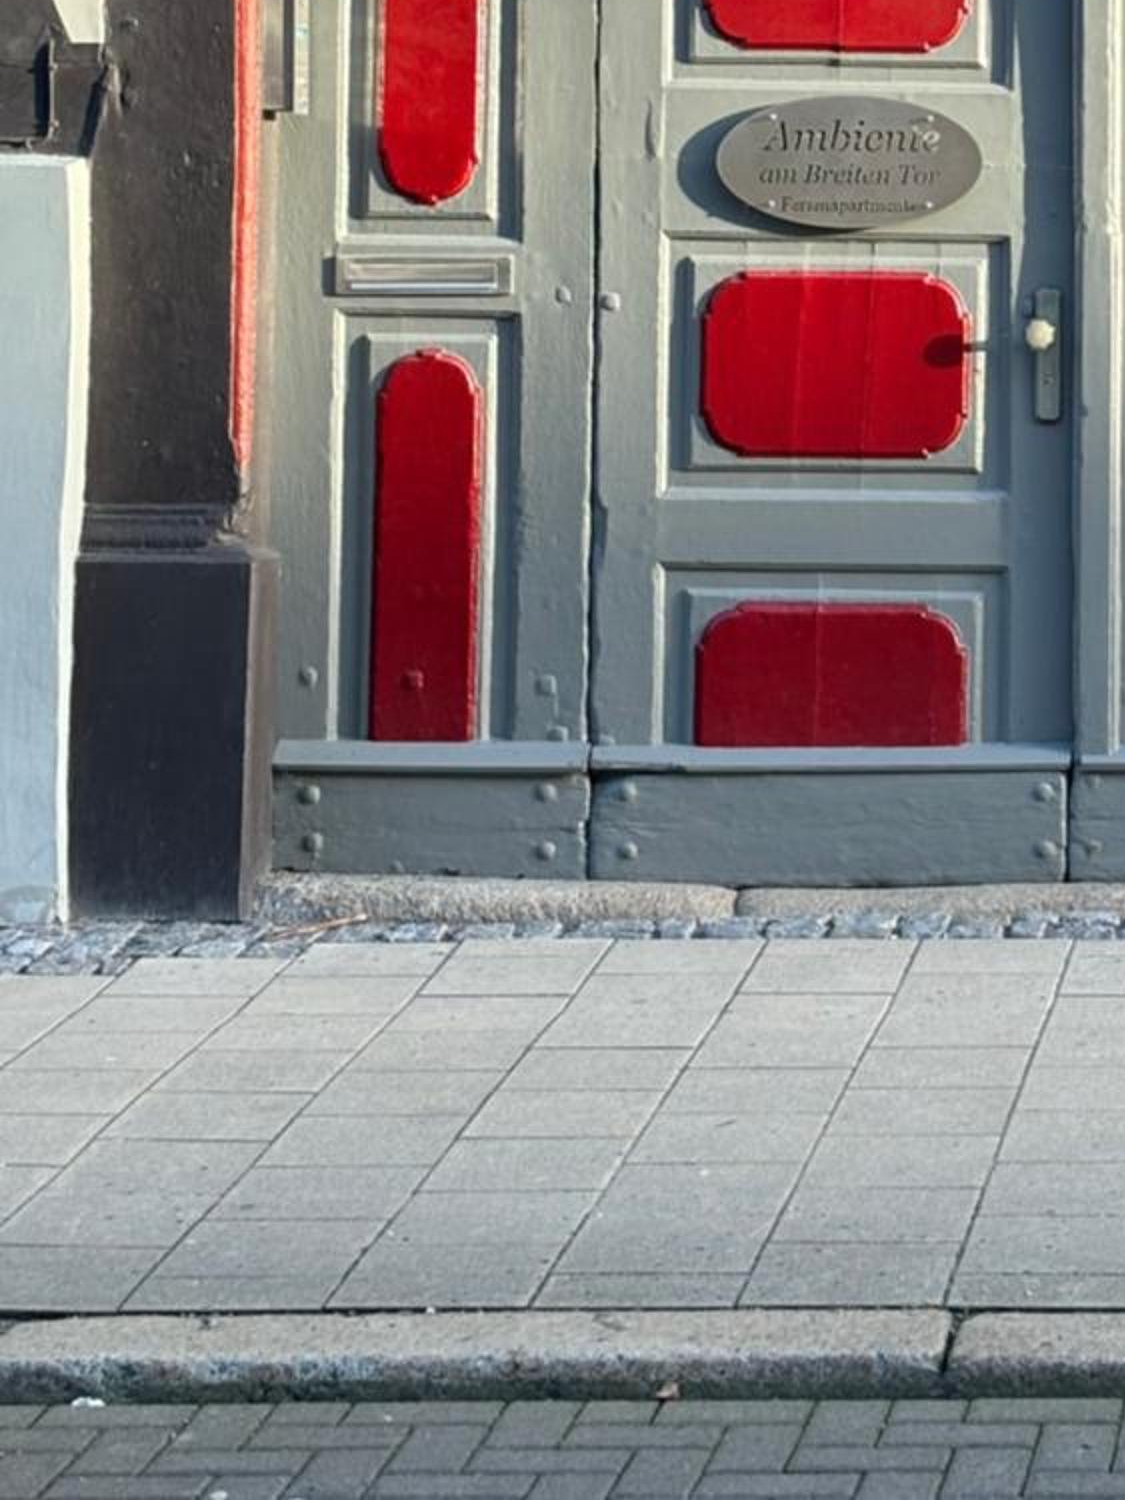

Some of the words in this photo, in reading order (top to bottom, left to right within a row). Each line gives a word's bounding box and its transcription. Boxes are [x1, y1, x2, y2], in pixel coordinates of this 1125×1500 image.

[761, 119, 942, 153] Ambiente
[758, 167, 798, 185] am
[803, 163, 891, 186] Breiten
[897, 164, 942, 186] Tor
